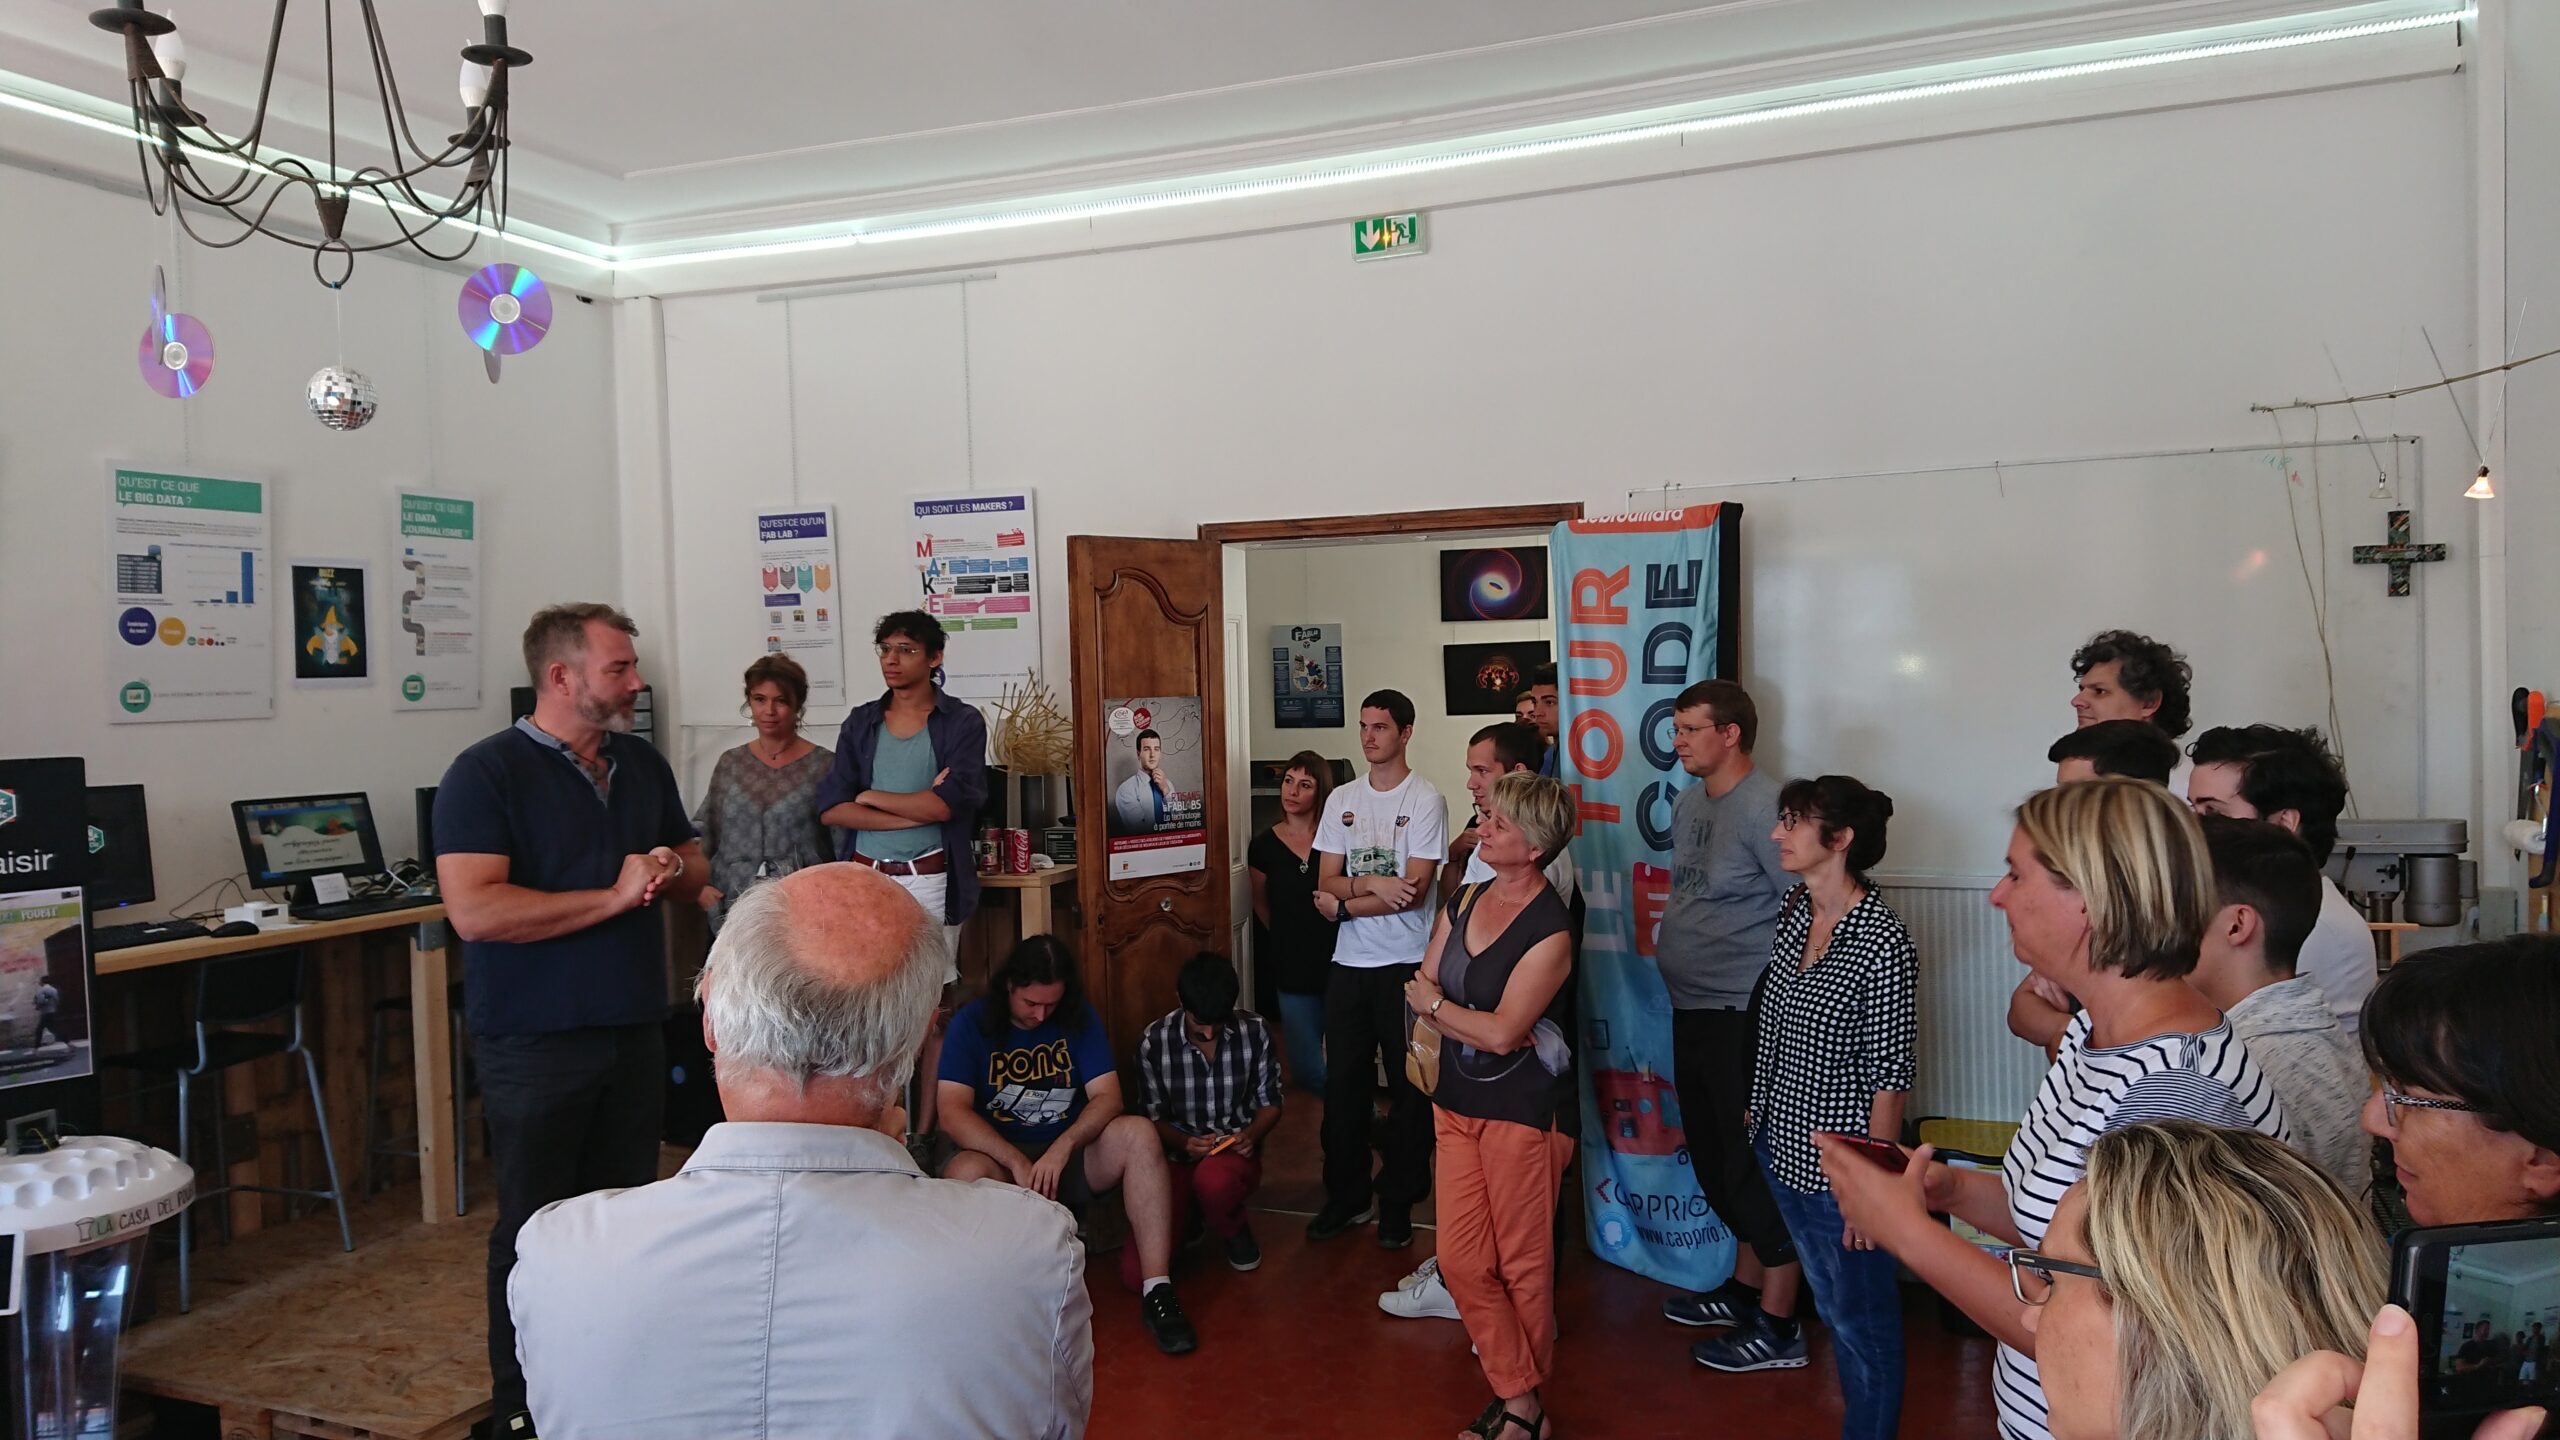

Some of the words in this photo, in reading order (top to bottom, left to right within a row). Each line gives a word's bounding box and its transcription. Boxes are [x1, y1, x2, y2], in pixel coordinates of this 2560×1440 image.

[118, 476, 157, 490] QU'EST
[161, 480, 175, 491] CE
[177, 481, 200, 493] QUE
[118, 490, 132, 502] LE
[135, 491, 154, 503] BIG
[156, 493, 185, 506] DATA
[916, 505, 931, 515] QUI
[932, 503, 954, 514] SONT
[955, 503, 971, 513] LES
[972, 501, 1007, 512] MAKERS
[403, 511, 414, 522] LE
[415, 513, 437, 524] DATA
[402, 525, 463, 538] JOURNALISME
[761, 530, 777, 539] FAB
[777, 529, 793, 539] LAB
[1568, 564, 1630, 837] TOUR
[96, 1221, 113, 1236] LA
[119, 1207, 151, 1230] CASA
[157, 1198, 174, 1217] DEL
